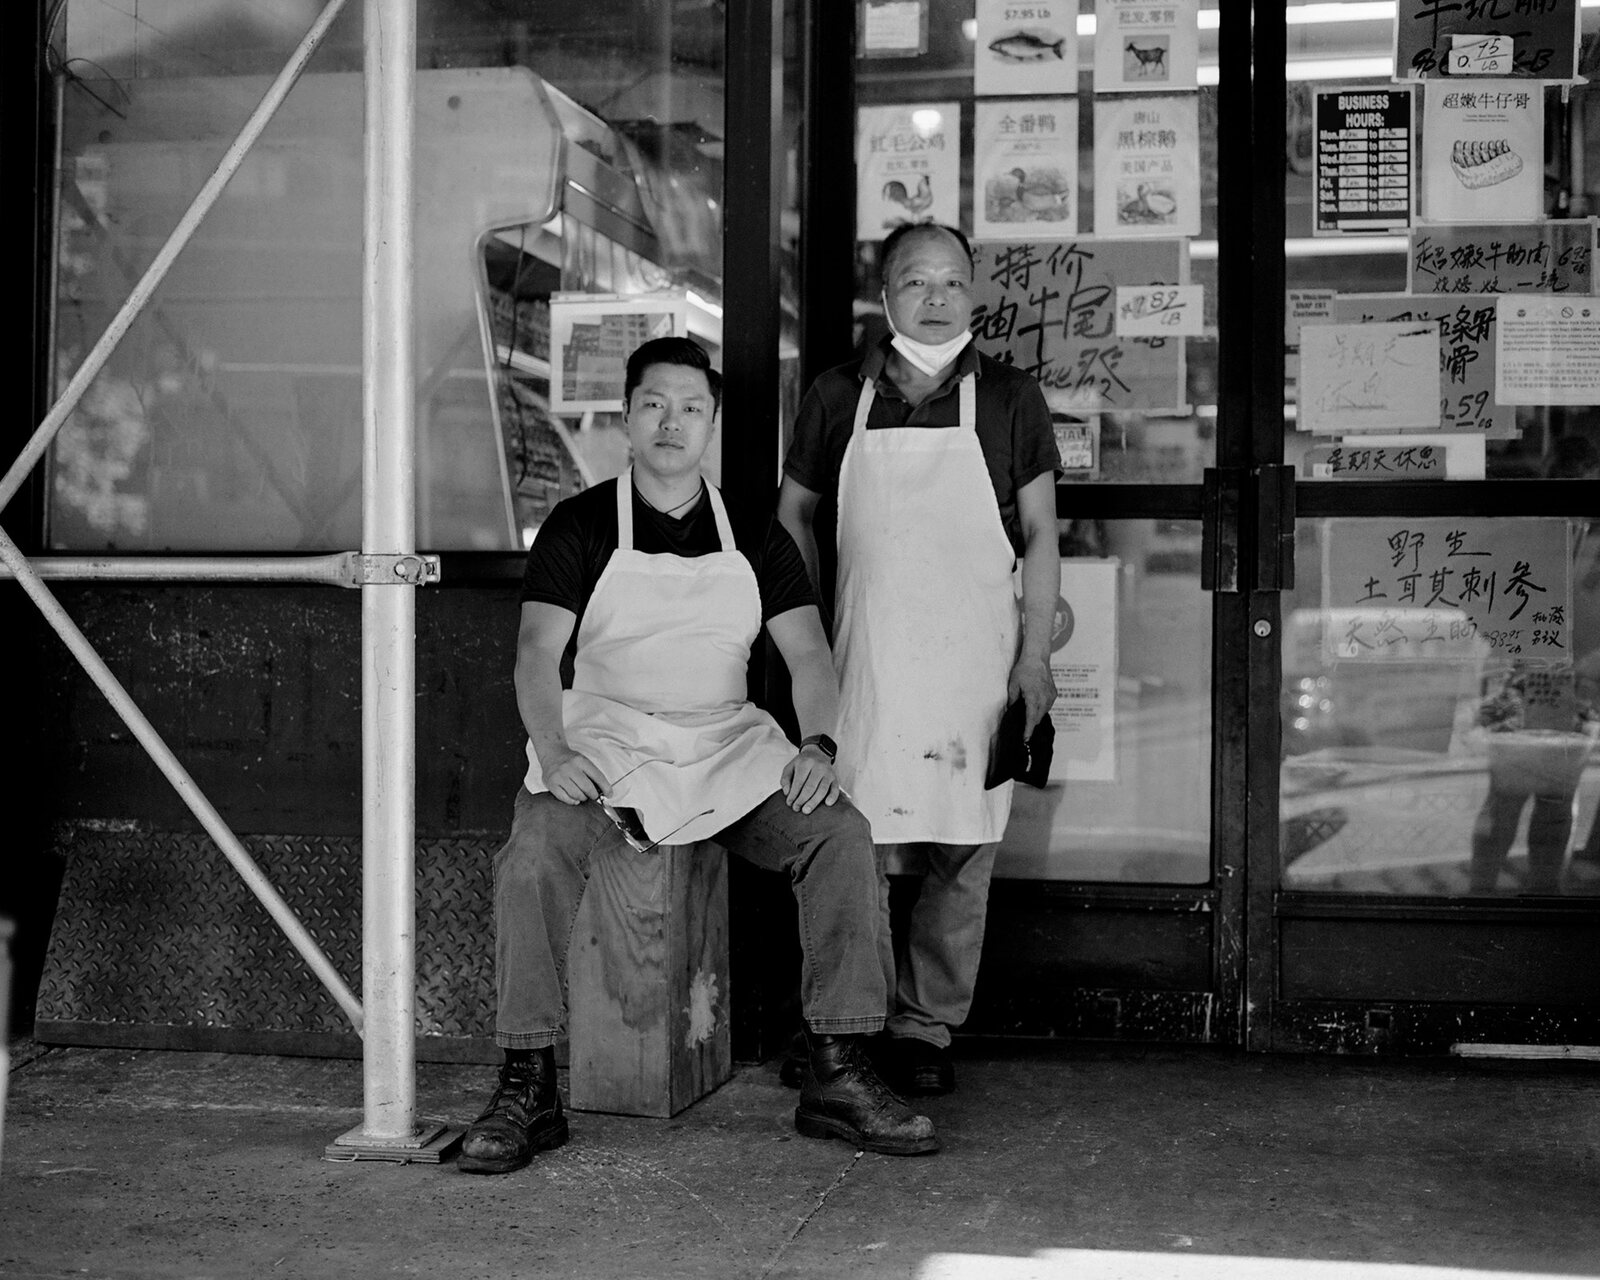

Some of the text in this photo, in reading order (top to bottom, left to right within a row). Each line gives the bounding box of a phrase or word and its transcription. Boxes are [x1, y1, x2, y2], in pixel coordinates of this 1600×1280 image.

[1338, 94, 1389, 110] BUSINESS
[1442, 92, 1530, 109] 超嫩牛仔骨
[1345, 112, 1385, 128] HOURS:
[1368, 129, 1378, 139] to
[1368, 141, 1378, 151] to
[1368, 153, 1378, 163] to
[1368, 165, 1378, 175] to
[1368, 177, 1378, 187] to
[1368, 189, 1378, 199] to
[1368, 201, 1378, 212] to
[991, 244, 1094, 290] 特价
[1327, 445, 1437, 473] 星期天休息
[1387, 529, 1492, 572] 野生
